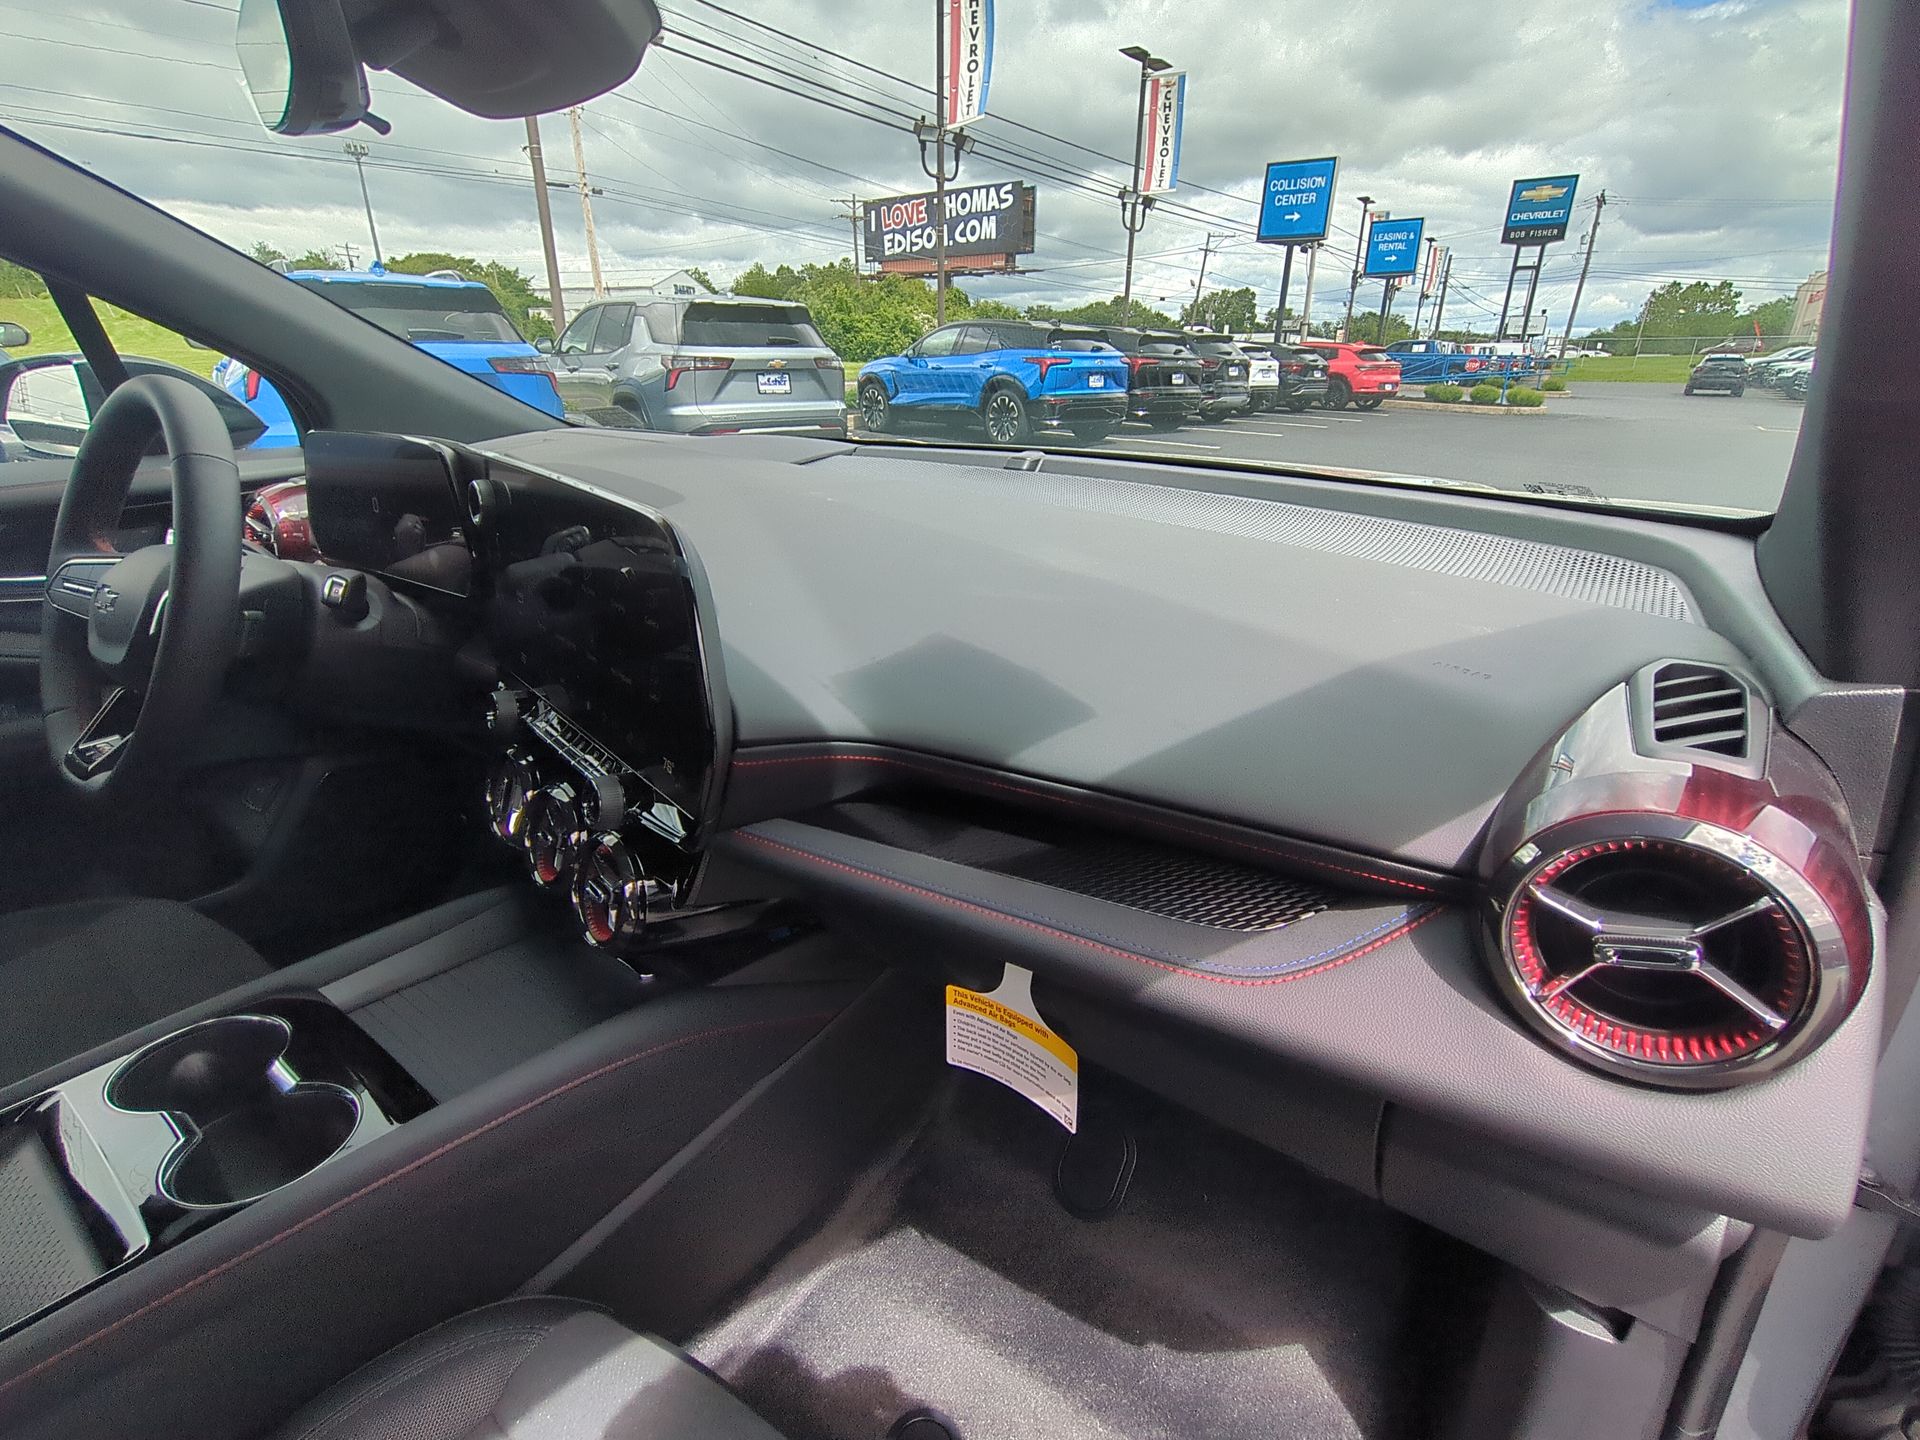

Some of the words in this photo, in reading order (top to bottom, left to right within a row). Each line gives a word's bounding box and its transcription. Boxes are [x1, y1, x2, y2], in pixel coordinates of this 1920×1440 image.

[1157, 90, 1172, 188] CHEVROLET
[1270, 176, 1326, 191] COLLISION
[1275, 192, 1317, 206] CENTER
[871, 210, 876, 232] I
[881, 197, 928, 231] LOVE
[1511, 209, 1566, 221] CHEVROLET
[1374, 231, 1407, 242] LEASING
[1409, 231, 1415, 240] &
[1510, 230, 1526, 239] BOB
[1530, 228, 1558, 238] FISHER
[1378, 241, 1408, 251] RENTAL
[1466, 361, 1480, 369] STOP
[953, 998, 987, 1014] Advanced
[988, 1010, 998, 1018] Air
[1000, 1014, 1016, 1028] Bags
[953, 990, 968, 999] This
[970, 994, 995, 1010] Vehicle
[1003, 1008, 1033, 1029] Equipped
[1034, 1024, 1049, 1039] with
